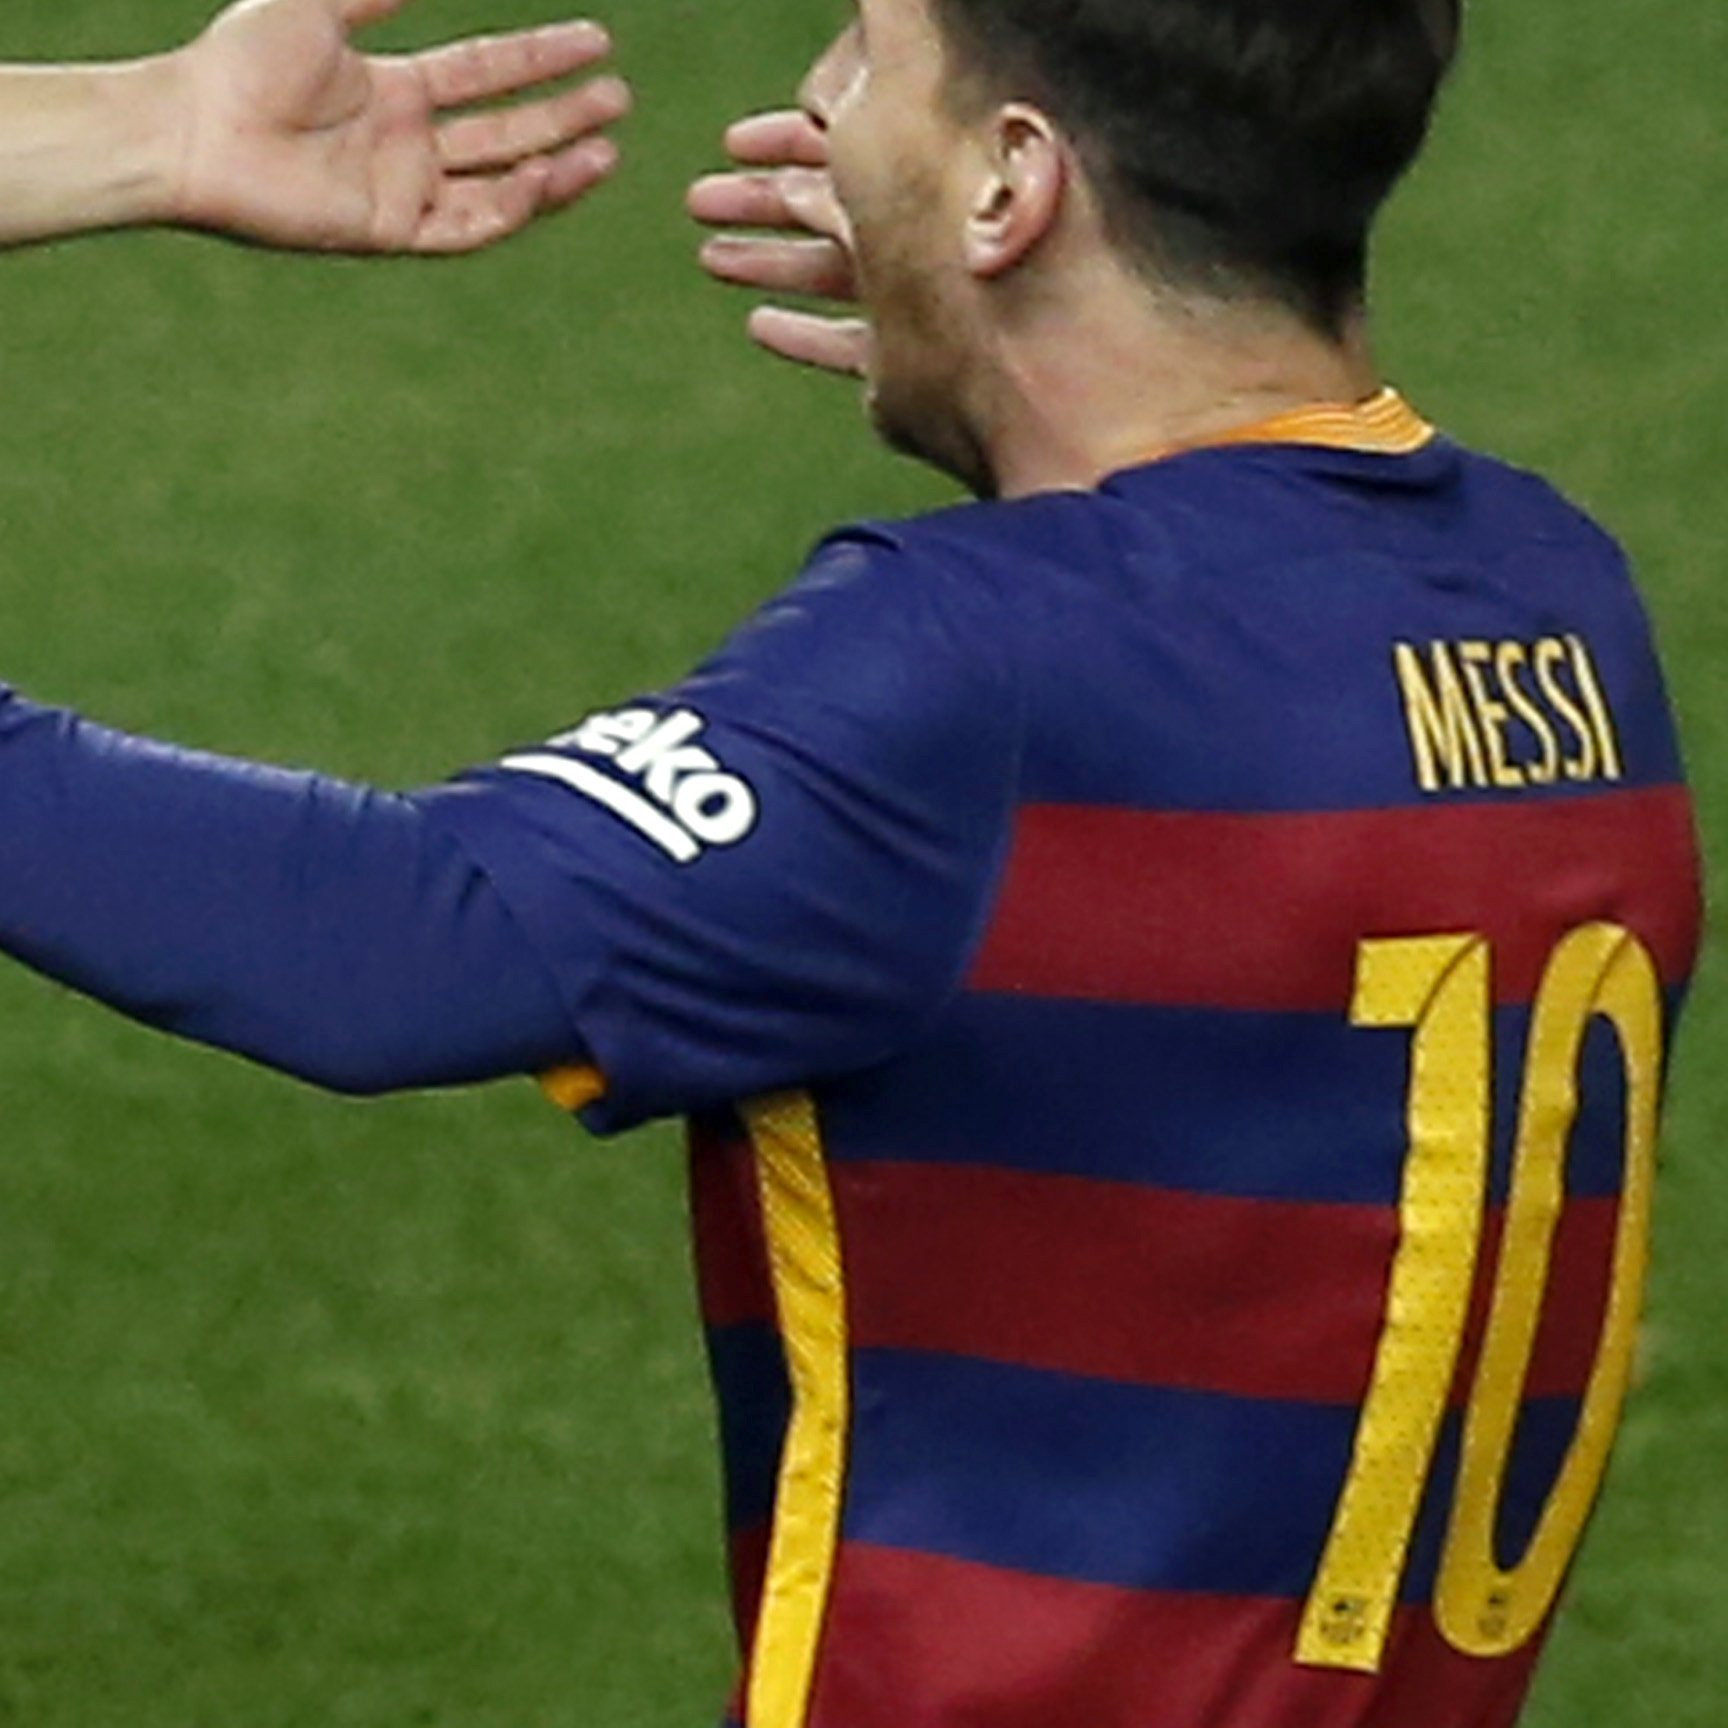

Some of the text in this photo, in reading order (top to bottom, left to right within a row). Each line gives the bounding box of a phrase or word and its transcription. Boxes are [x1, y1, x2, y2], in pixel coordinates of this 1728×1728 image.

[546, 708, 757, 844] eko
[1394, 633, 1620, 792] MESSI
[1294, 921, 1663, 1672] 10
